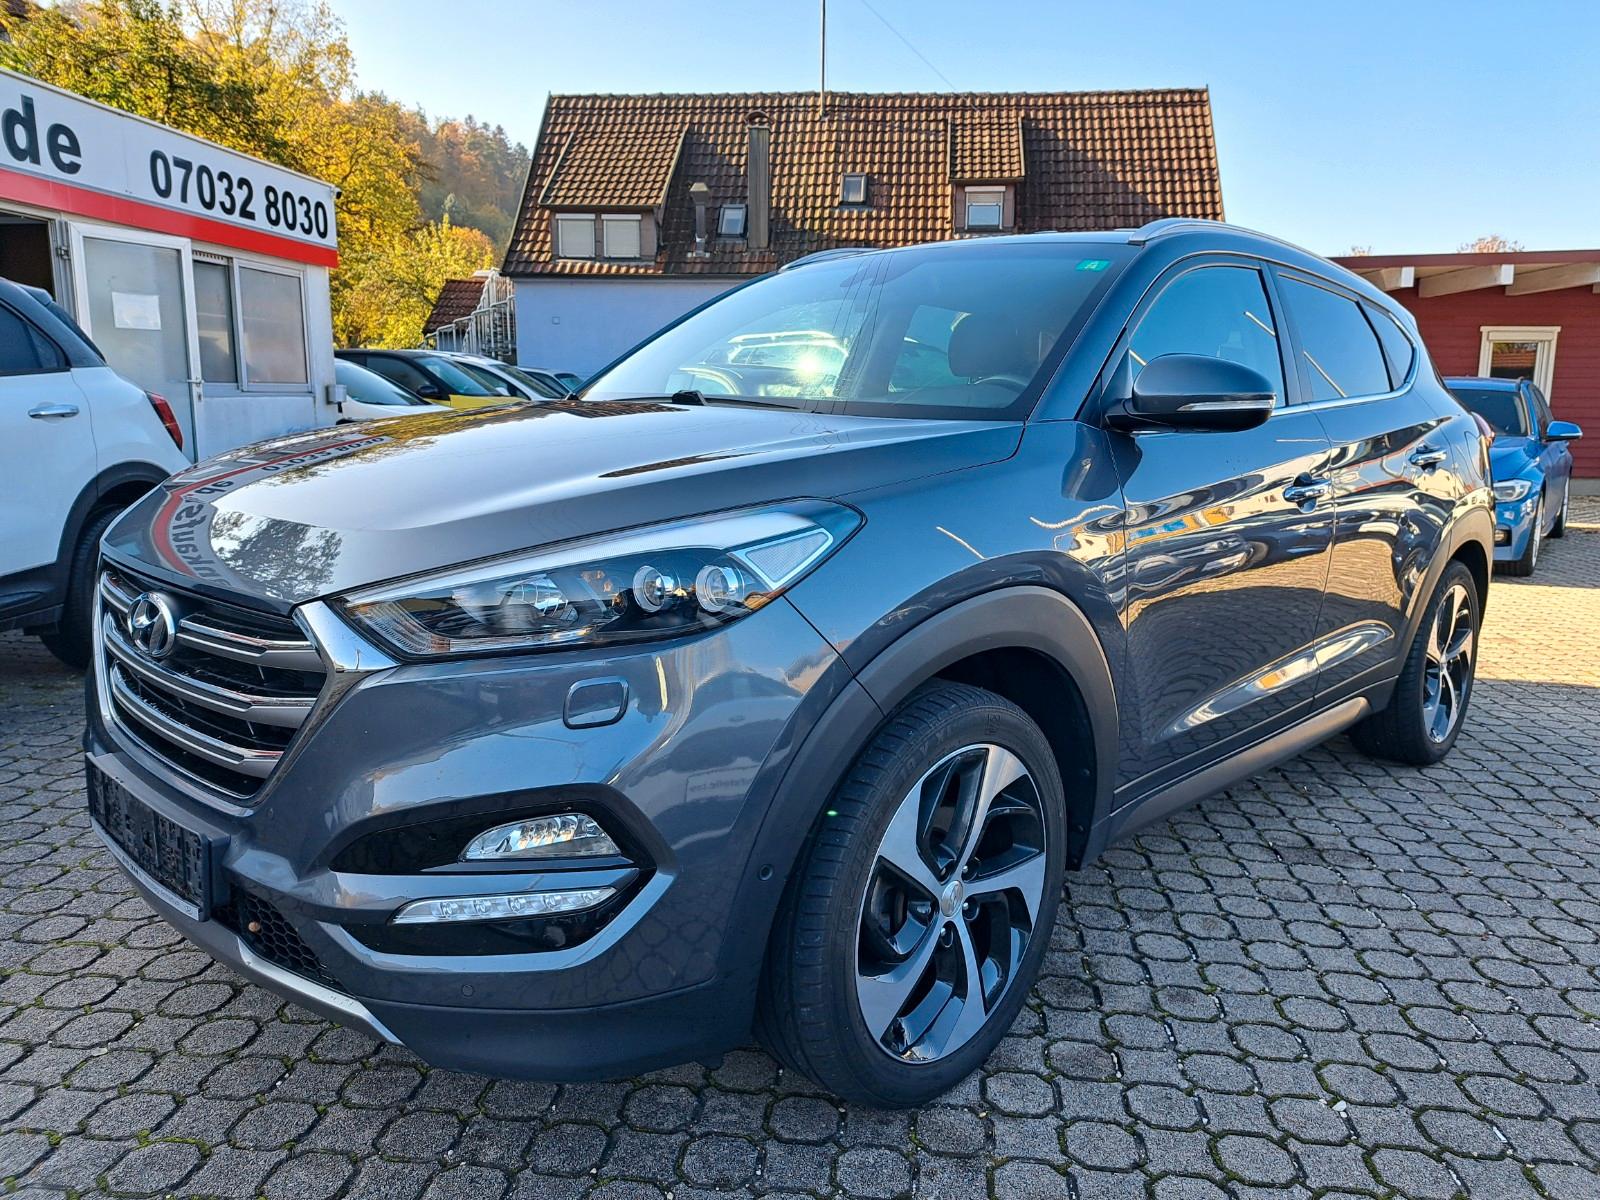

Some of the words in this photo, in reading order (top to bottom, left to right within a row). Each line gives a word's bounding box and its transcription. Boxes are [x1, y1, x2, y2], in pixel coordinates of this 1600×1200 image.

[1, 94, 82, 174] de
[150, 150, 256, 221] 07032
[265, 185, 328, 239] 8030
